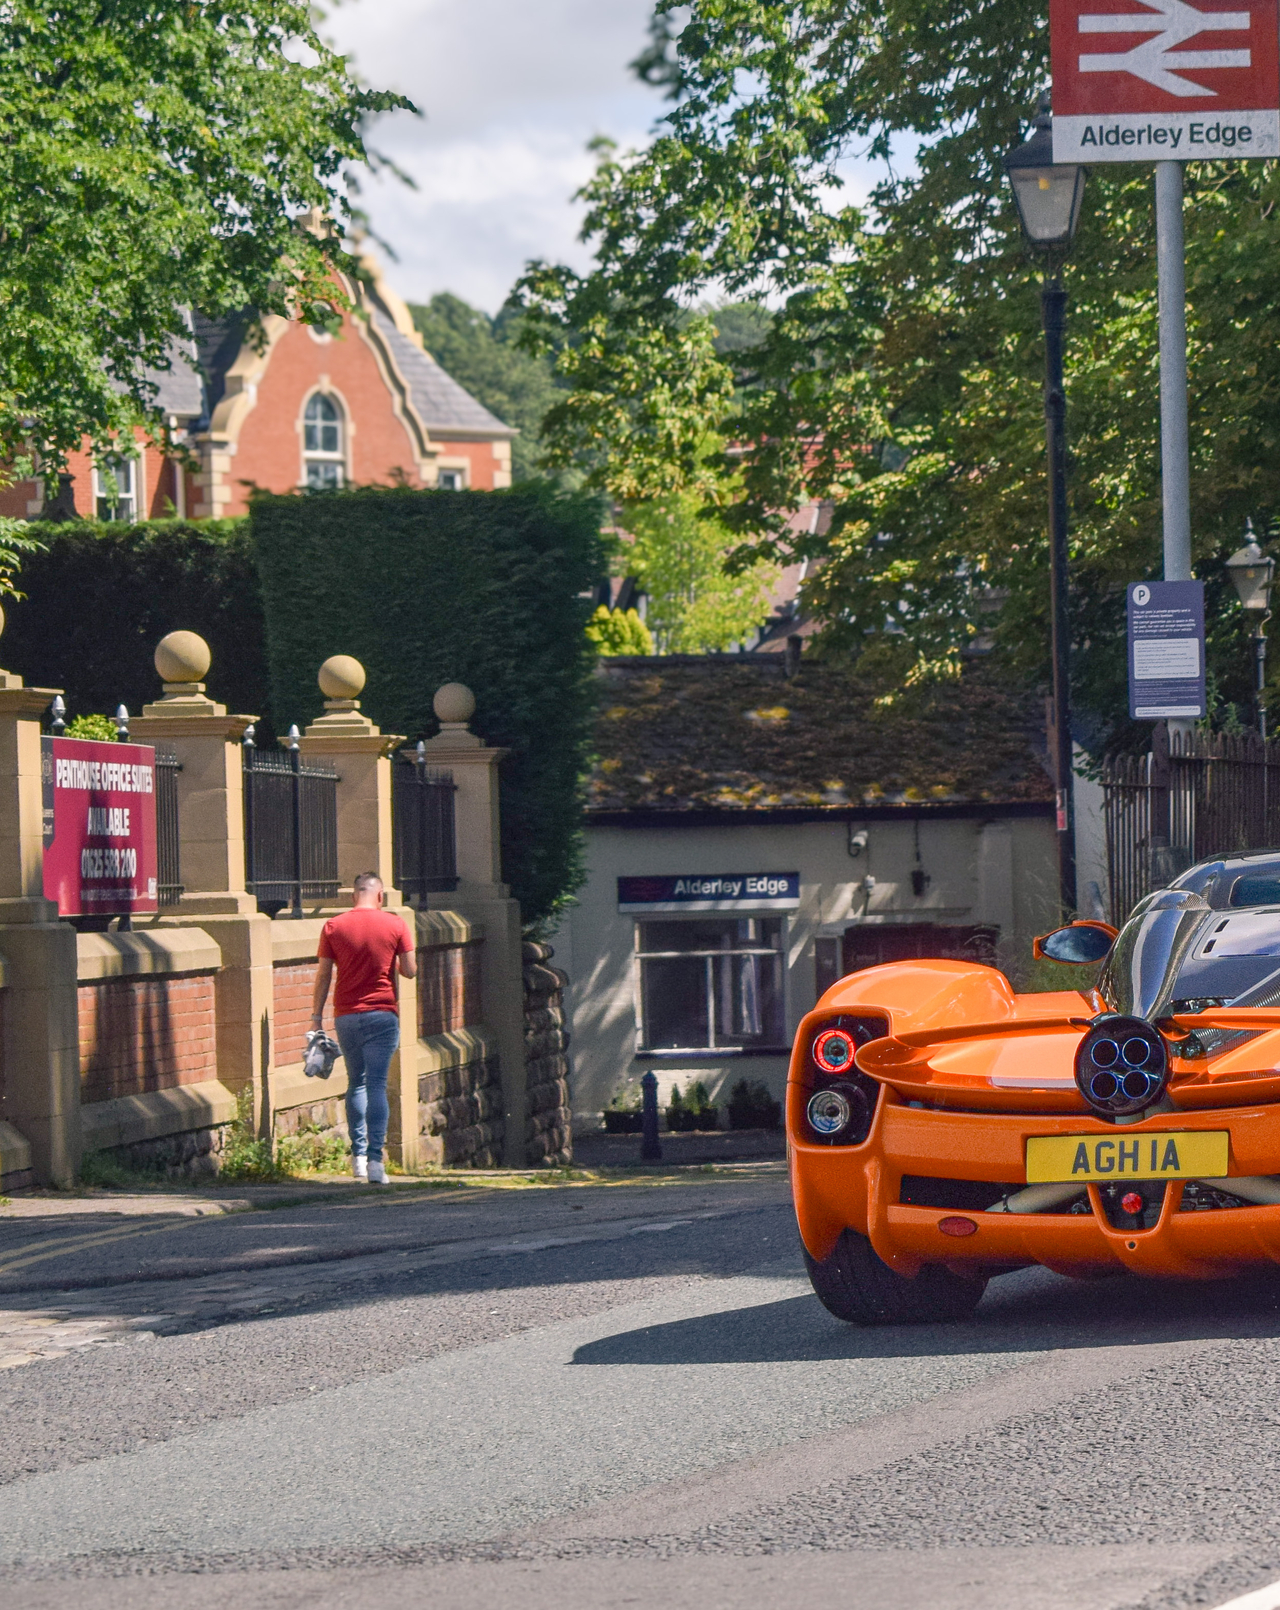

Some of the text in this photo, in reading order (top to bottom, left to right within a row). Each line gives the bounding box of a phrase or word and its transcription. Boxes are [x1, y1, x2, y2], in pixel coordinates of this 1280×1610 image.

[1080, 122, 1252, 148] Alderley Edge
[1139, 590, 1145, 600] P
[56, 759, 153, 793] PENTHOUSE OFFICE SUITES
[88, 807, 130, 836] AVAILABLE
[120, 848, 137, 879] 200
[674, 876, 789, 897] Alderley Edge
[1071, 1139, 1139, 1174] AGH
